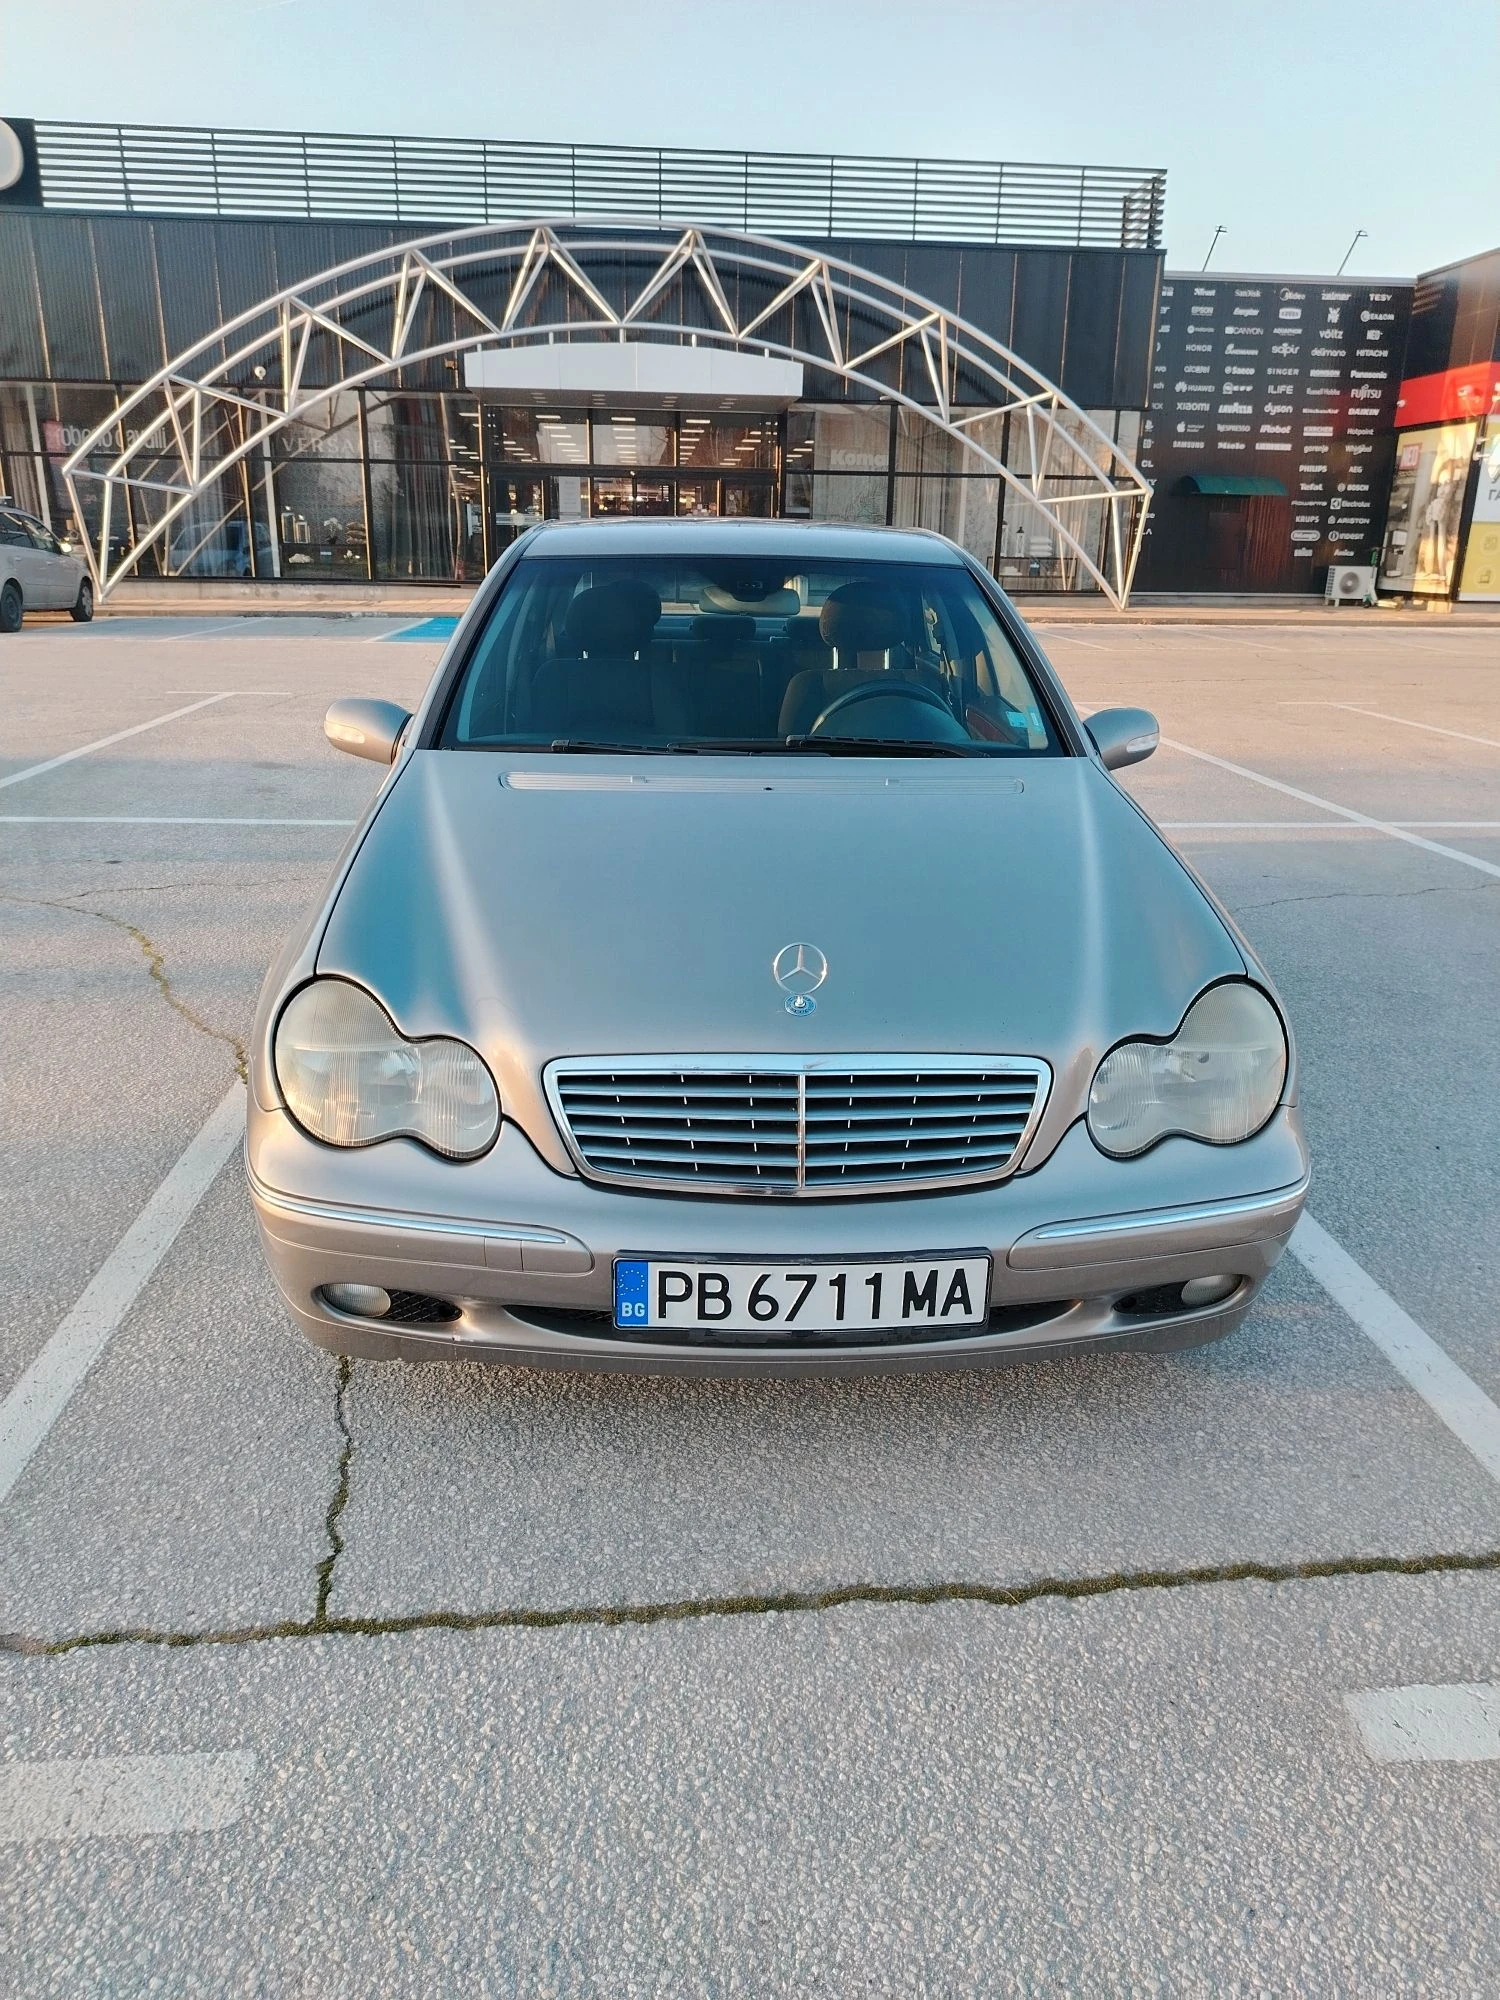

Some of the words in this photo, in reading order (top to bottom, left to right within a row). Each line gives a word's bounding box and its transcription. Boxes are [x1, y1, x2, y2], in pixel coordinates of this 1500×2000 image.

[1234, 289, 1262, 298] SanDisk
[1369, 293, 1392, 302] TESY
[1191, 306, 1214, 314] EPSON
[1233, 327, 1264, 336] CANYON
[1185, 344, 1213, 353] HONOR
[1311, 348, 1346, 357] delimano
[1356, 349, 1389, 358] HITACHI
[1266, 368, 1300, 376] SINGER
[1350, 370, 1388, 379] Panasonic
[1188, 385, 1216, 393] HUAWEI
[1267, 385, 1294, 395] ILIFE
[1350, 388, 1382, 400] FUJITSU
[1264, 402, 1293, 415] dyson
[1348, 408, 1380, 416] DAIKIN
[1347, 428, 1375, 437] Hotpoint
[281, 437, 381, 454] VERSAE
[1173, 440, 1205, 449] SAMSUNG
[1217, 442, 1247, 450] Miele
[830, 449, 889, 466] Koma
[1299, 465, 1328, 473] PHILIPS
[1348, 466, 1364, 474] AEG
[1347, 484, 1370, 492] BOSCH
[1341, 500, 1371, 508] Electrolux
[1295, 515, 1320, 523] KRUPS
[1336, 517, 1371, 525] ARISTON
[657, 1270, 732, 1321] PB
[747, 1272, 883, 1322] 6711
[902, 1268, 973, 1319] MA
[621, 1302, 645, 1317] BG
